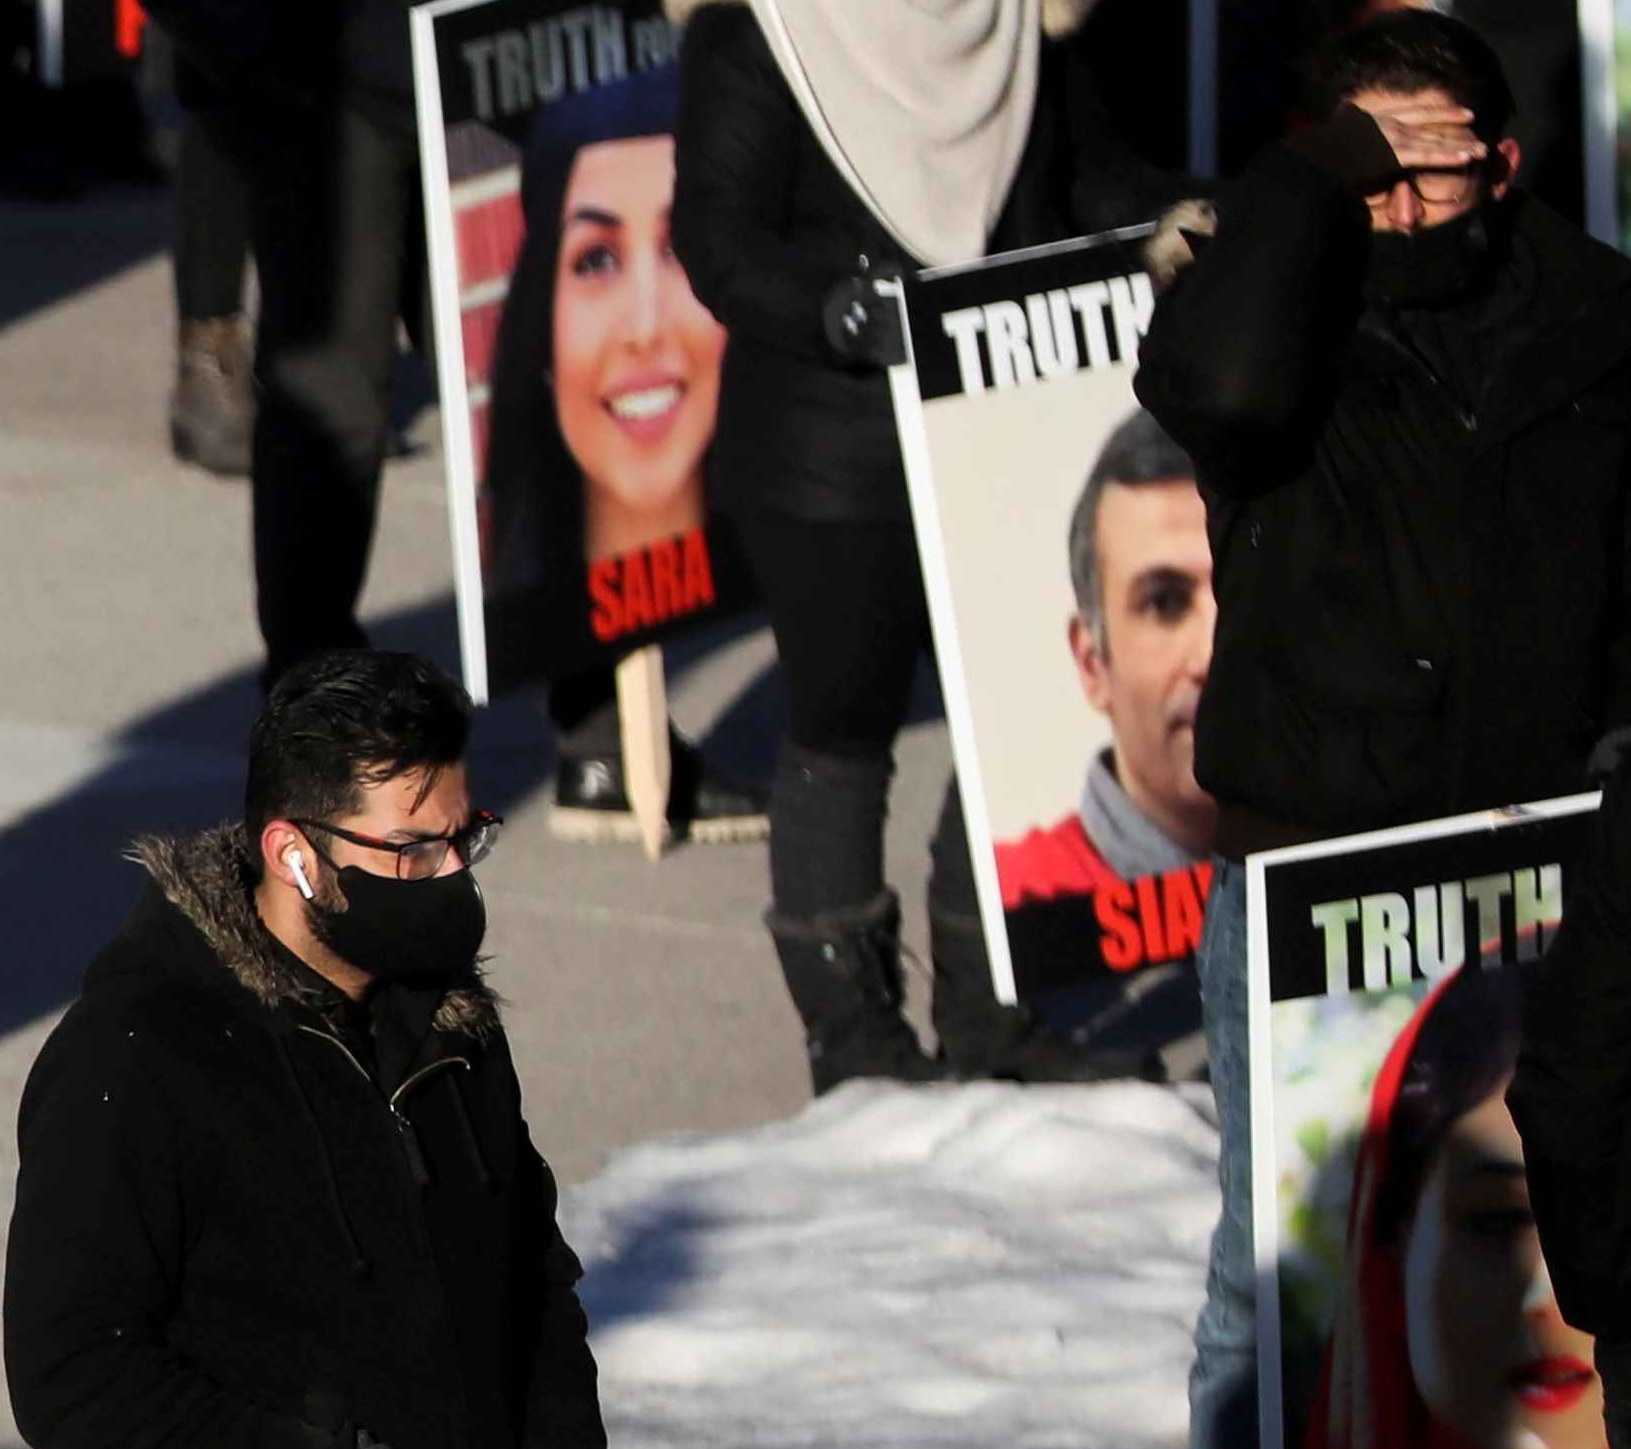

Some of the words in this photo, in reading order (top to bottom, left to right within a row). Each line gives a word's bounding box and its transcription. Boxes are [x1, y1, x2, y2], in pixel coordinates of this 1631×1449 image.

[462, 5, 628, 120] TRUTH
[941, 271, 1156, 396] TRUTH
[589, 527, 715, 642] SARA
[1311, 863, 1563, 998] TRUTH
